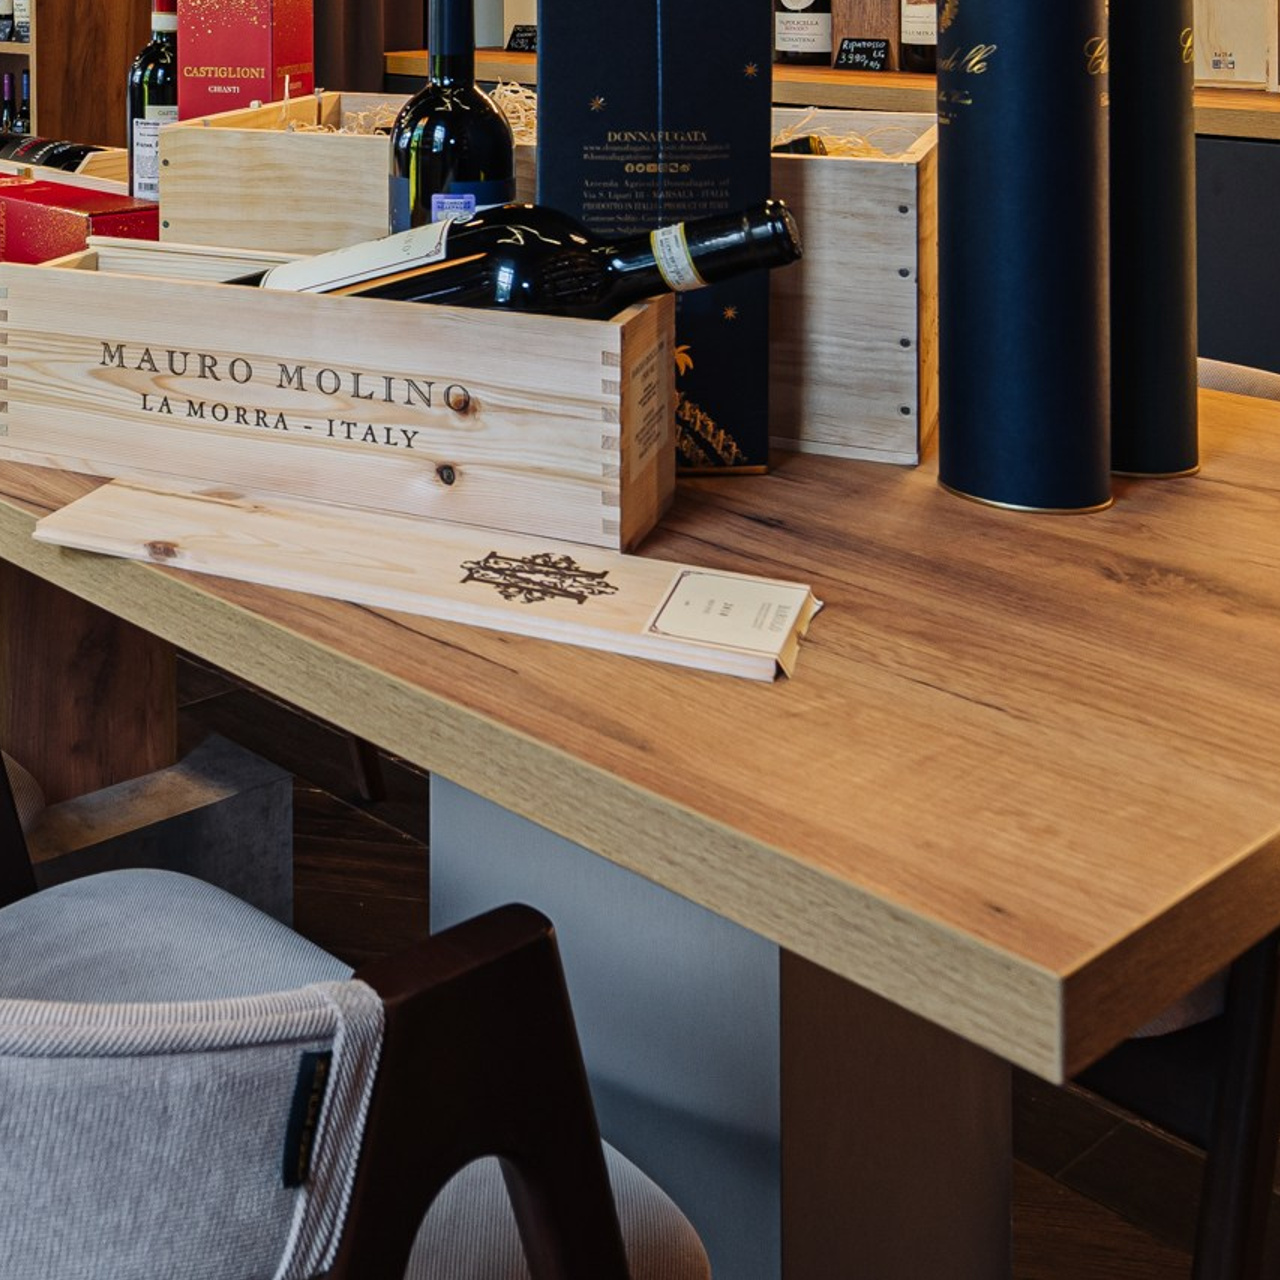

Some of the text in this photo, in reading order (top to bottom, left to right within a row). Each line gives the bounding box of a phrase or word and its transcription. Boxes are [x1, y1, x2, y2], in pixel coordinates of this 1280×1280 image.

[182, 66, 266, 80] CASTIGLIONI
[207, 85, 241, 94] CHIANTI
[607, 130, 708, 143] DONNAFUGATA
[99, 341, 472, 414] MAURO MOLINO
[141, 393, 173, 415] LA
[186, 399, 290, 432] MORRA
[327, 418, 421, 449] ITALY
